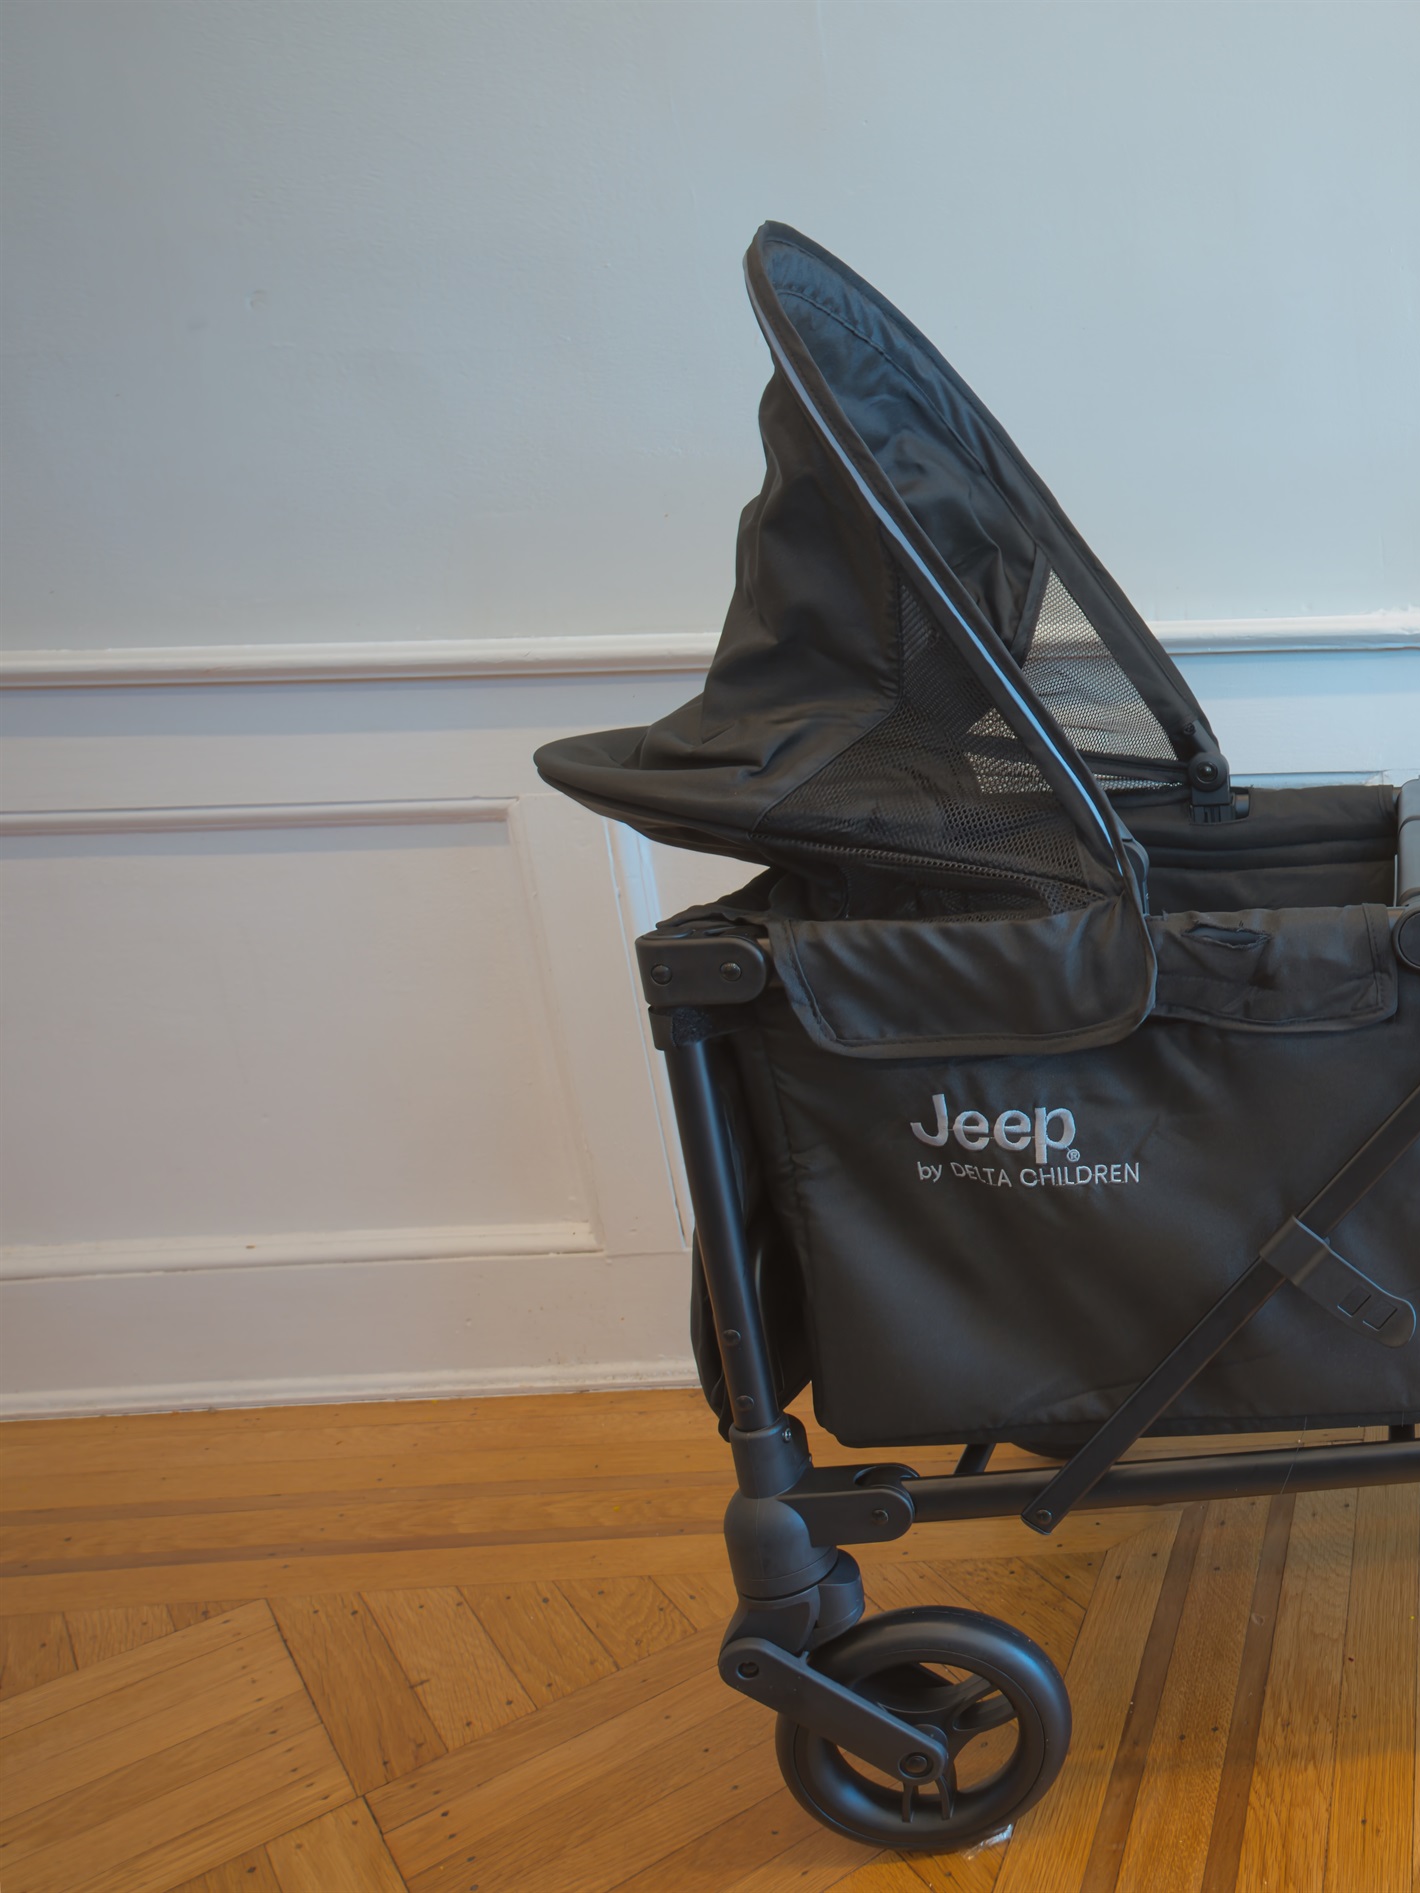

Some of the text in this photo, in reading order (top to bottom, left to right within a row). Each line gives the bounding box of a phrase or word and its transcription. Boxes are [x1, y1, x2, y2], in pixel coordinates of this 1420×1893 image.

[910, 1093, 1076, 1164] Jeep
[917, 1161, 1140, 1188] by DELTA CHILDREN
